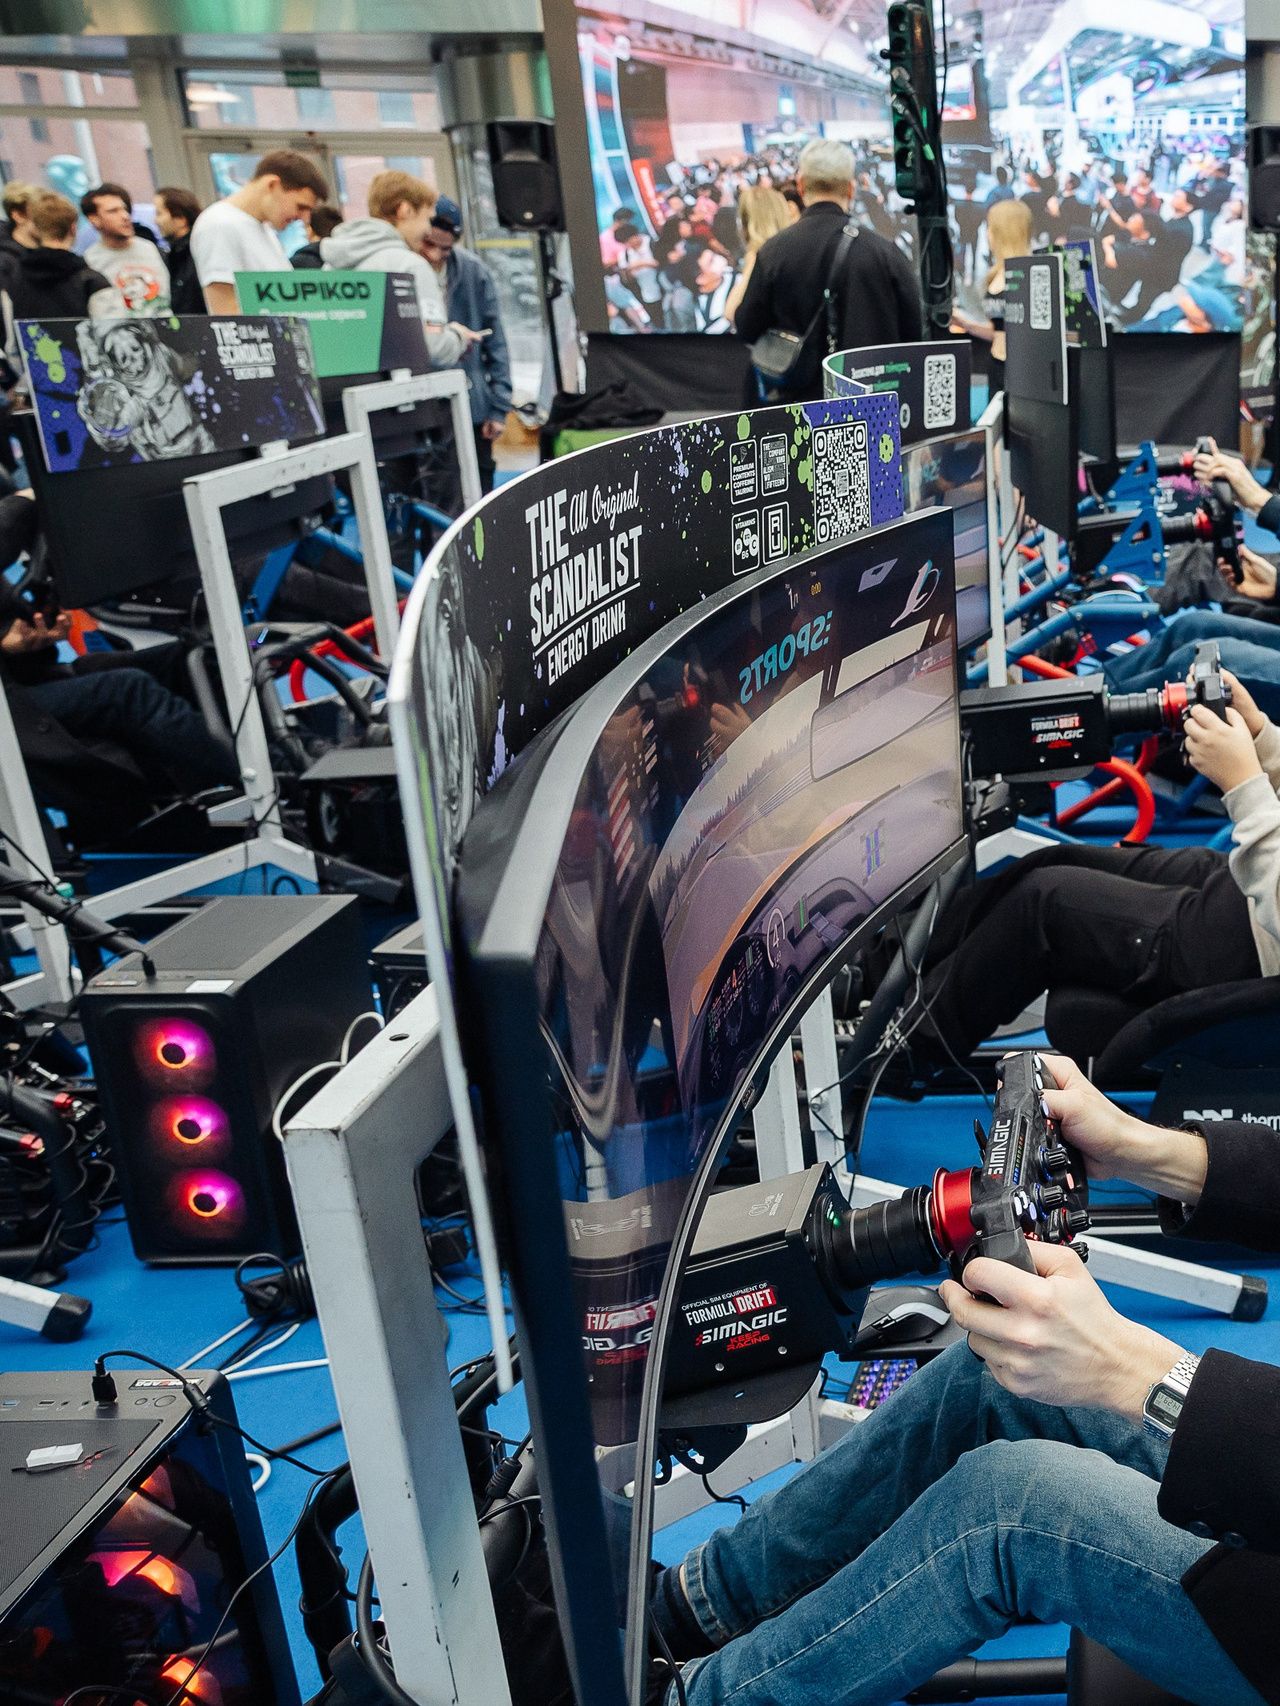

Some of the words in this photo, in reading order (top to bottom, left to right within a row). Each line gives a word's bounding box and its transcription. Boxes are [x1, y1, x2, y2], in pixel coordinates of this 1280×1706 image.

[255, 281, 371, 302] KUPIKOD
[210, 321, 242, 347] THE
[732, 470, 755, 481] CONTENTS
[733, 462, 754, 473] PREMIUM
[735, 486, 754, 496] TAURINE
[525, 488, 570, 579] THE
[569, 489, 589, 536] All
[592, 470, 640, 531] Original
[735, 518, 756, 530] VITAMINS
[529, 524, 643, 648] SCANDALIST
[548, 621, 589, 686] ENERGY
[592, 599, 626, 650] DRINK
[1036, 728, 1085, 743] SIMAGIC
[988, 1119, 1011, 1175] SIMAGIC
[681, 1299, 710, 1311] OFFICIAL
[709, 1295, 722, 1303] SIM
[721, 1286, 758, 1300] EQUIPMENT
[685, 1301, 737, 1326] FORMULA
[735, 1288, 773, 1314] DRIFT
[702, 1308, 788, 1345] SIMAGIC
[730, 1330, 761, 1345] KEEP
[726, 1333, 771, 1352] RACING
